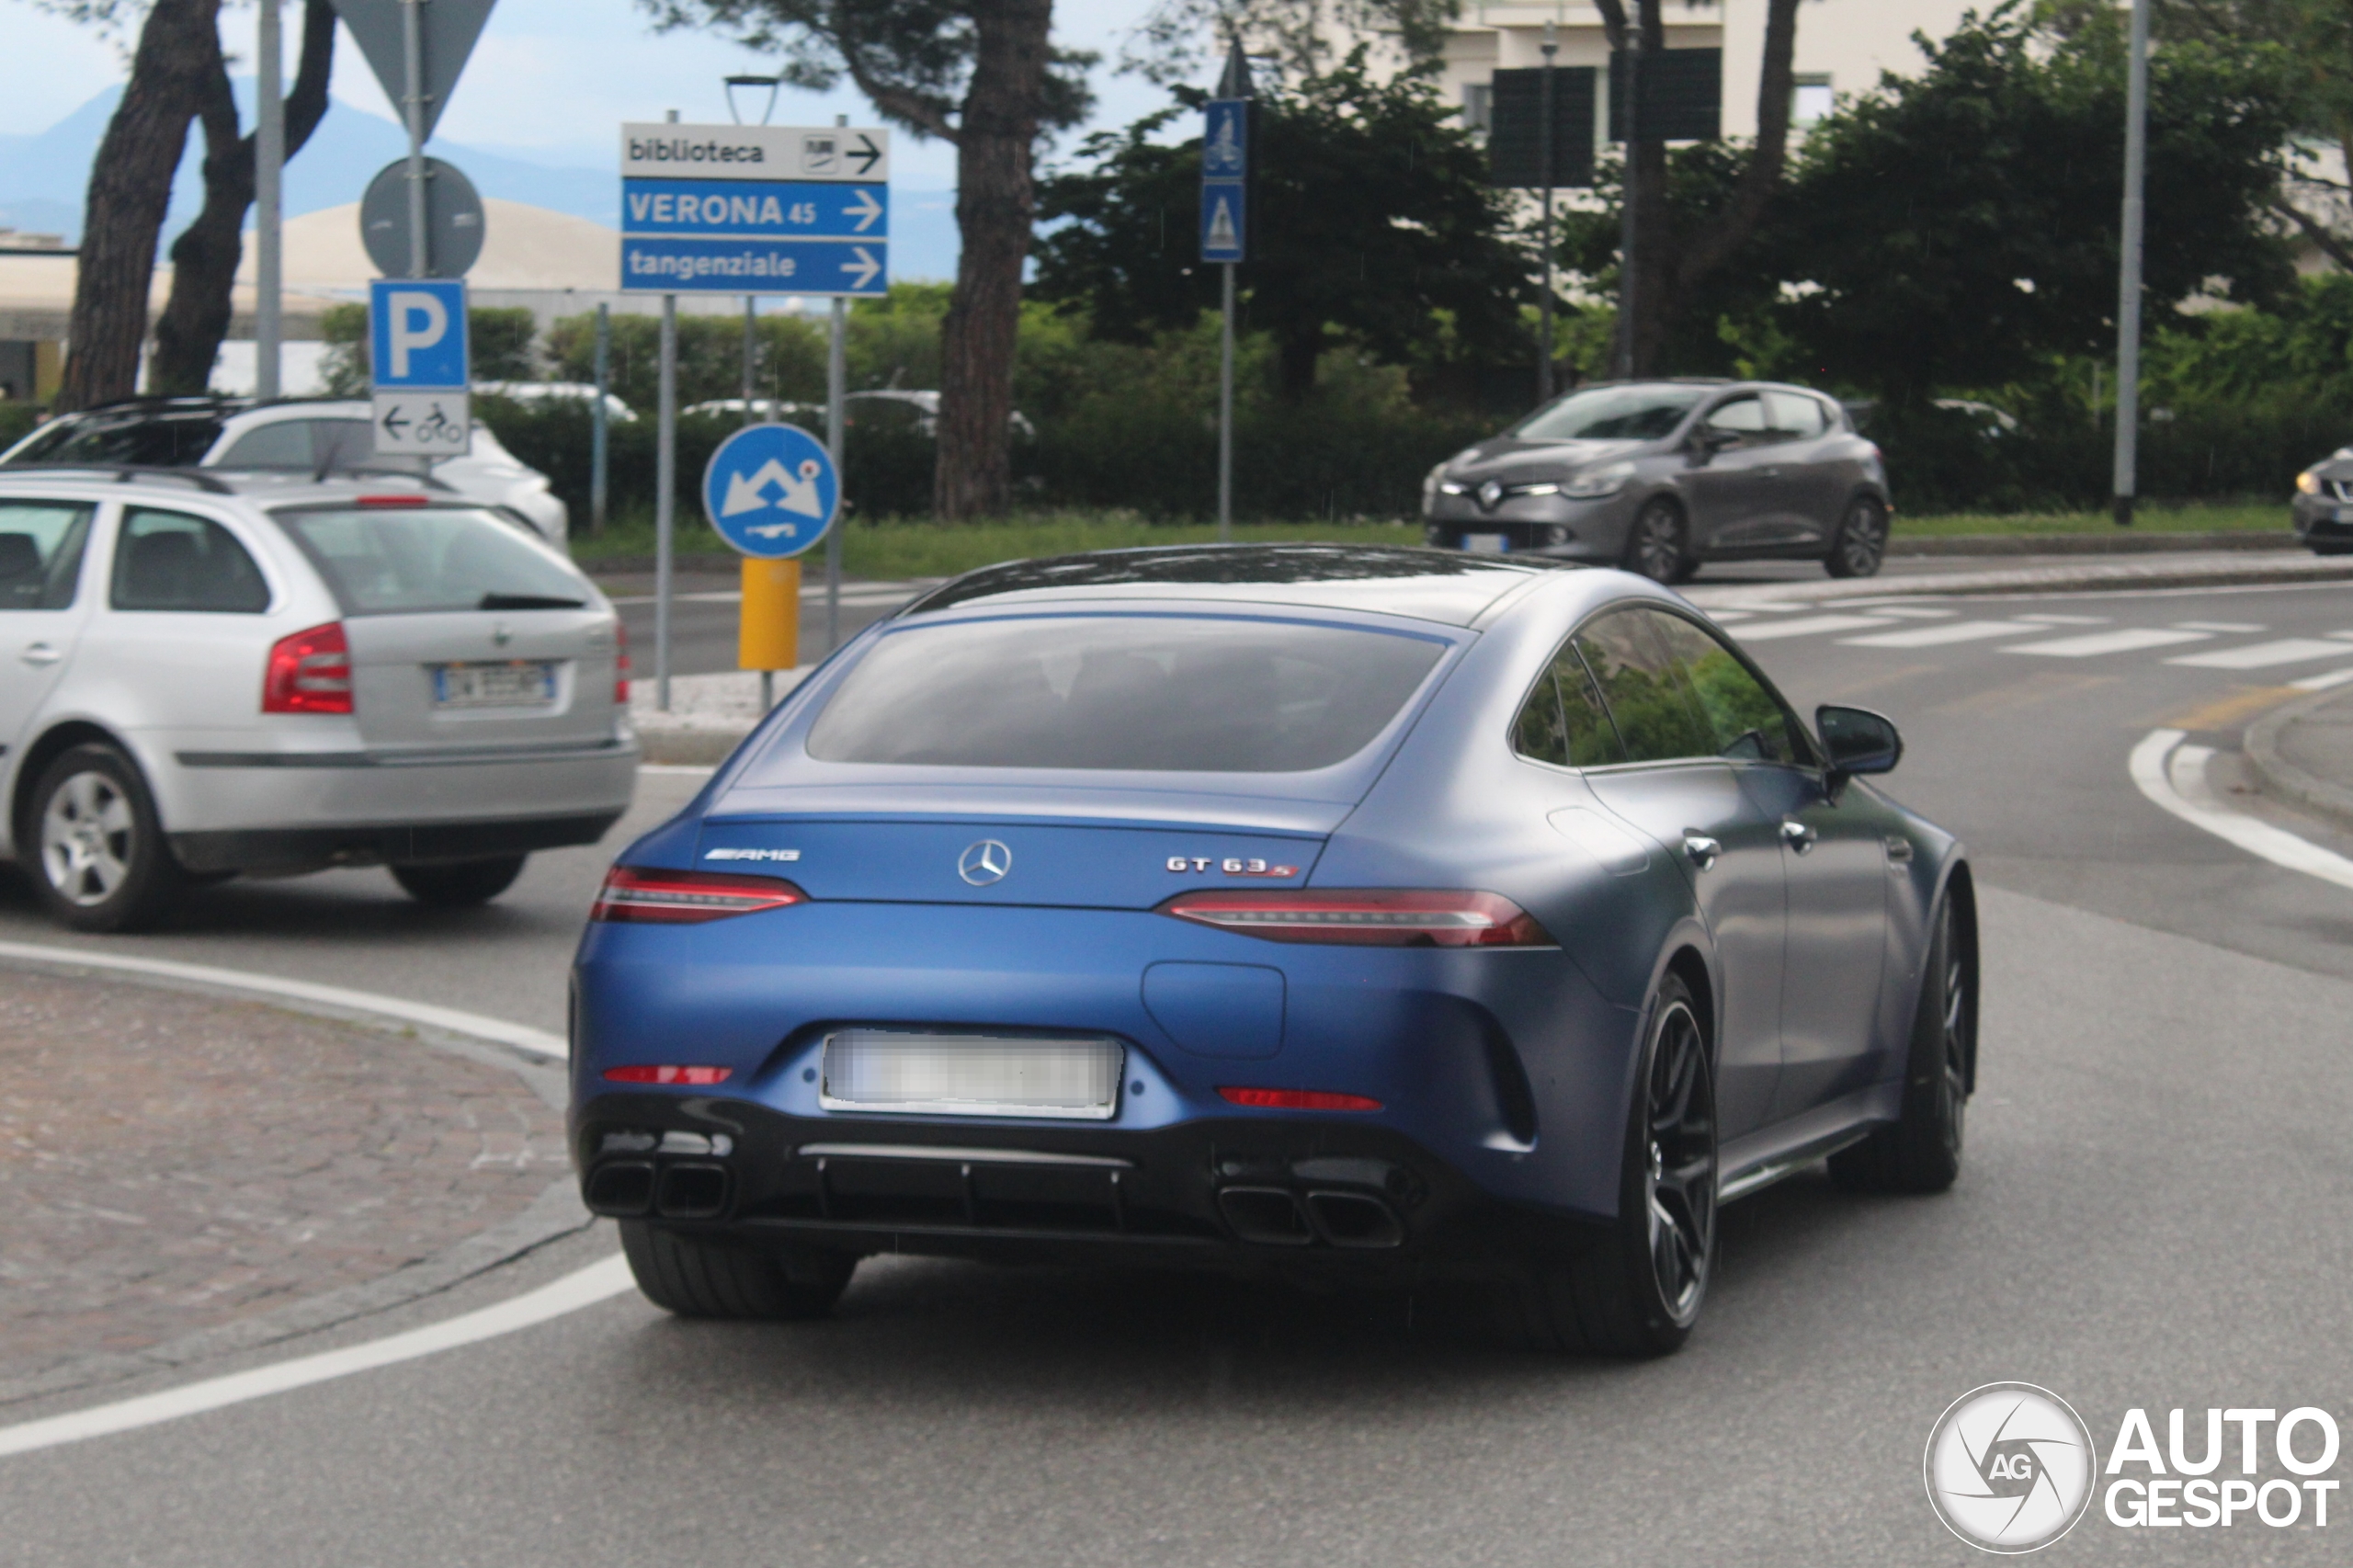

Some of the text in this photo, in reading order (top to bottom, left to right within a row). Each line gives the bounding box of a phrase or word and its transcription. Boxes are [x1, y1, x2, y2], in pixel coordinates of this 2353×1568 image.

[630, 139, 765, 163] biblioteca
[629, 193, 816, 225] VERONA 45
[629, 249, 797, 279] tangenziale
[389, 291, 448, 378] P
[733, 848, 801, 861] AMG
[1166, 857, 1212, 872] GT
[1222, 858, 1267, 872] 63
